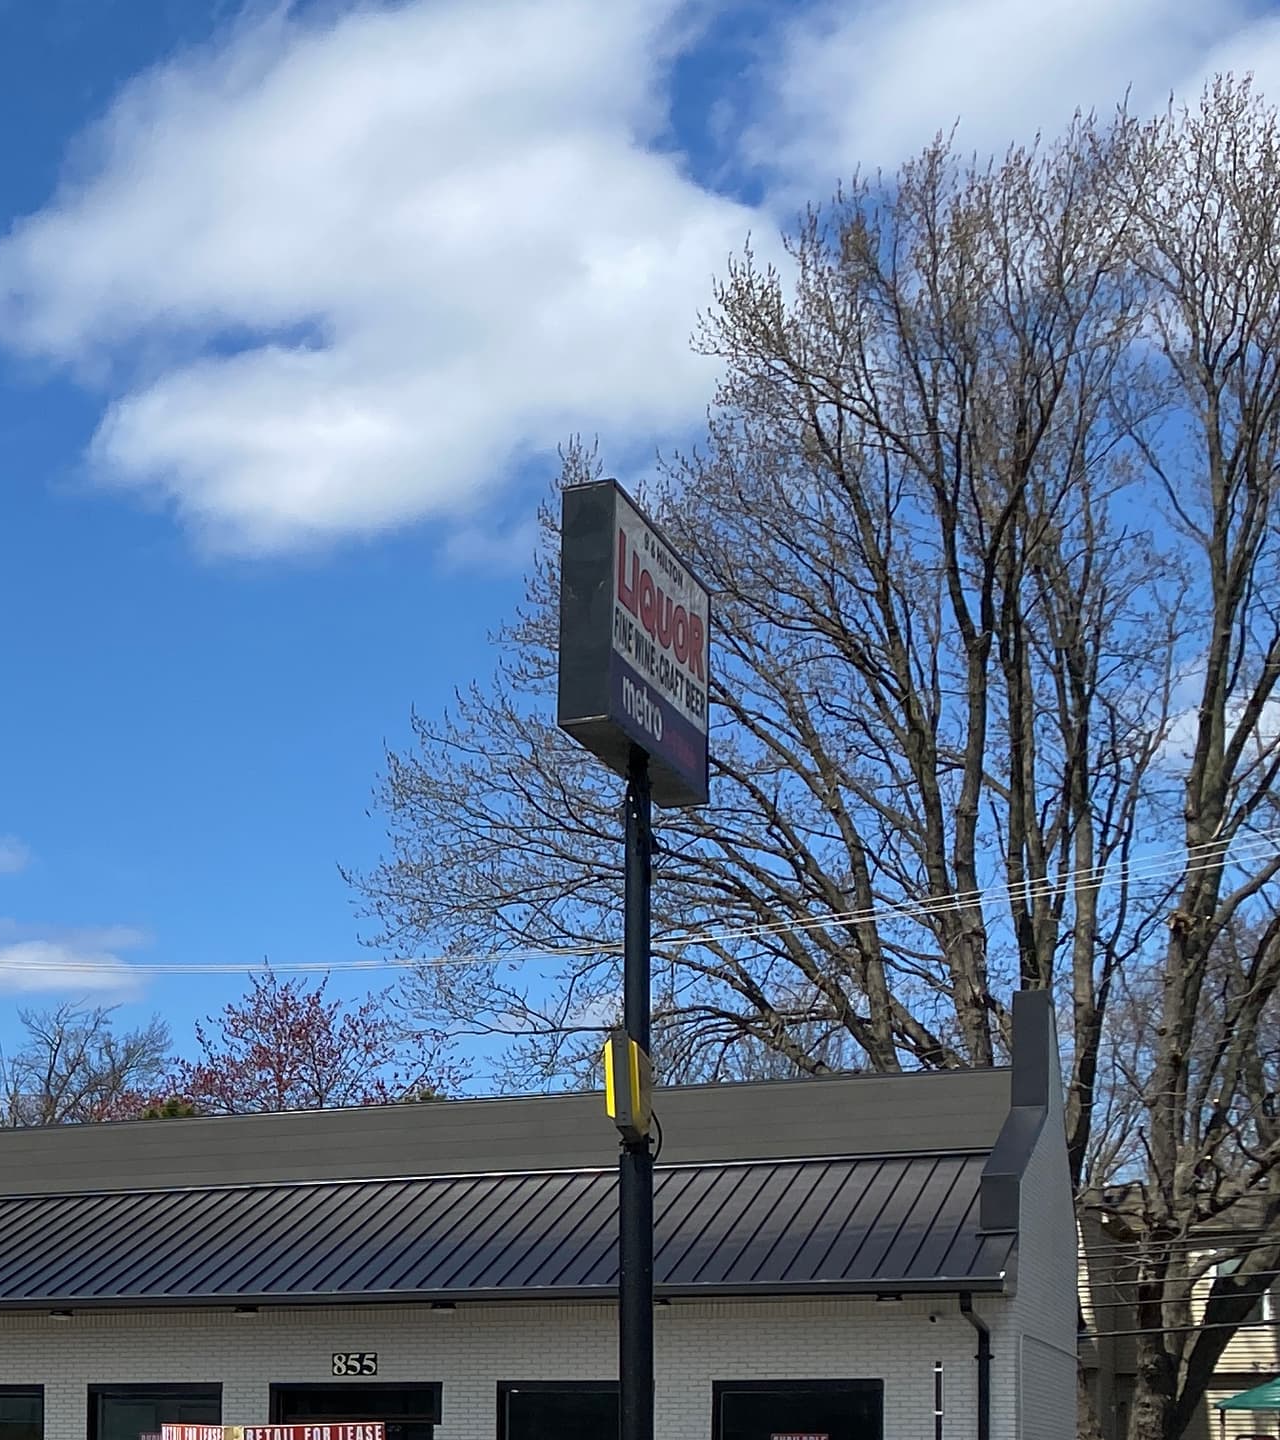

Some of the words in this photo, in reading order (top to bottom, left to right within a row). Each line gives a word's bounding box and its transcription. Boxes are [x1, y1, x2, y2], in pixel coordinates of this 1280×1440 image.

[618, 527, 704, 684] LIQUOR
[614, 606, 633, 654] FINE
[634, 629, 655, 677] WINE
[659, 654, 684, 702] CRAFT
[685, 678, 706, 720] BEER
[622, 676, 664, 742] metro
[333, 1354, 377, 1375] 855
